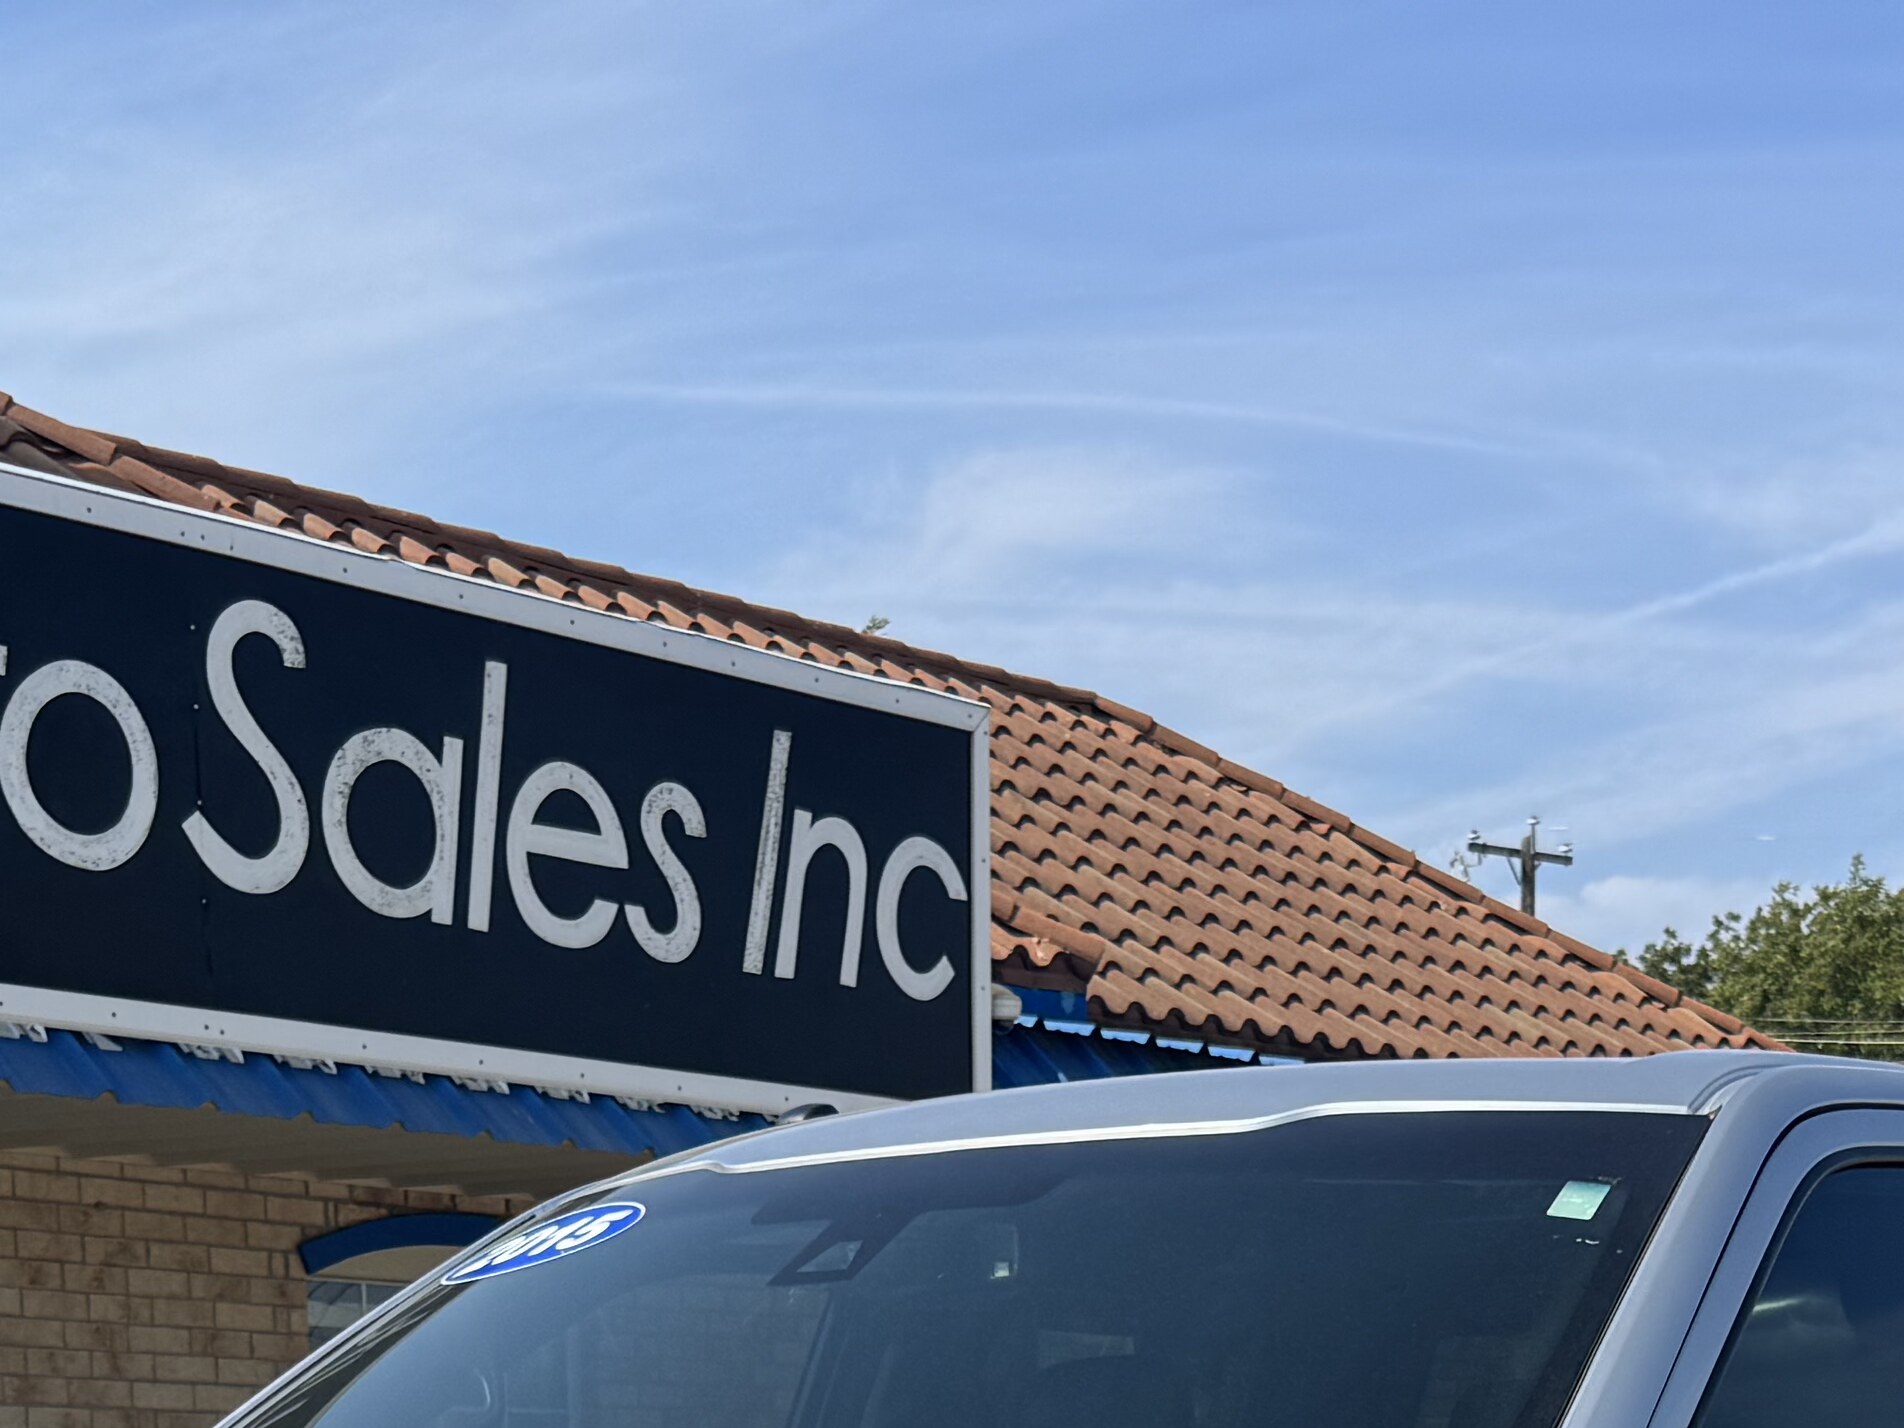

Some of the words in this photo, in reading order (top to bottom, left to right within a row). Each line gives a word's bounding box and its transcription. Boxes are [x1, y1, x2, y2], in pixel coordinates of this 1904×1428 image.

[181, 600, 706, 963] Sales
[742, 730, 968, 1001] Inc
[452, 1209, 634, 1278] 2015
